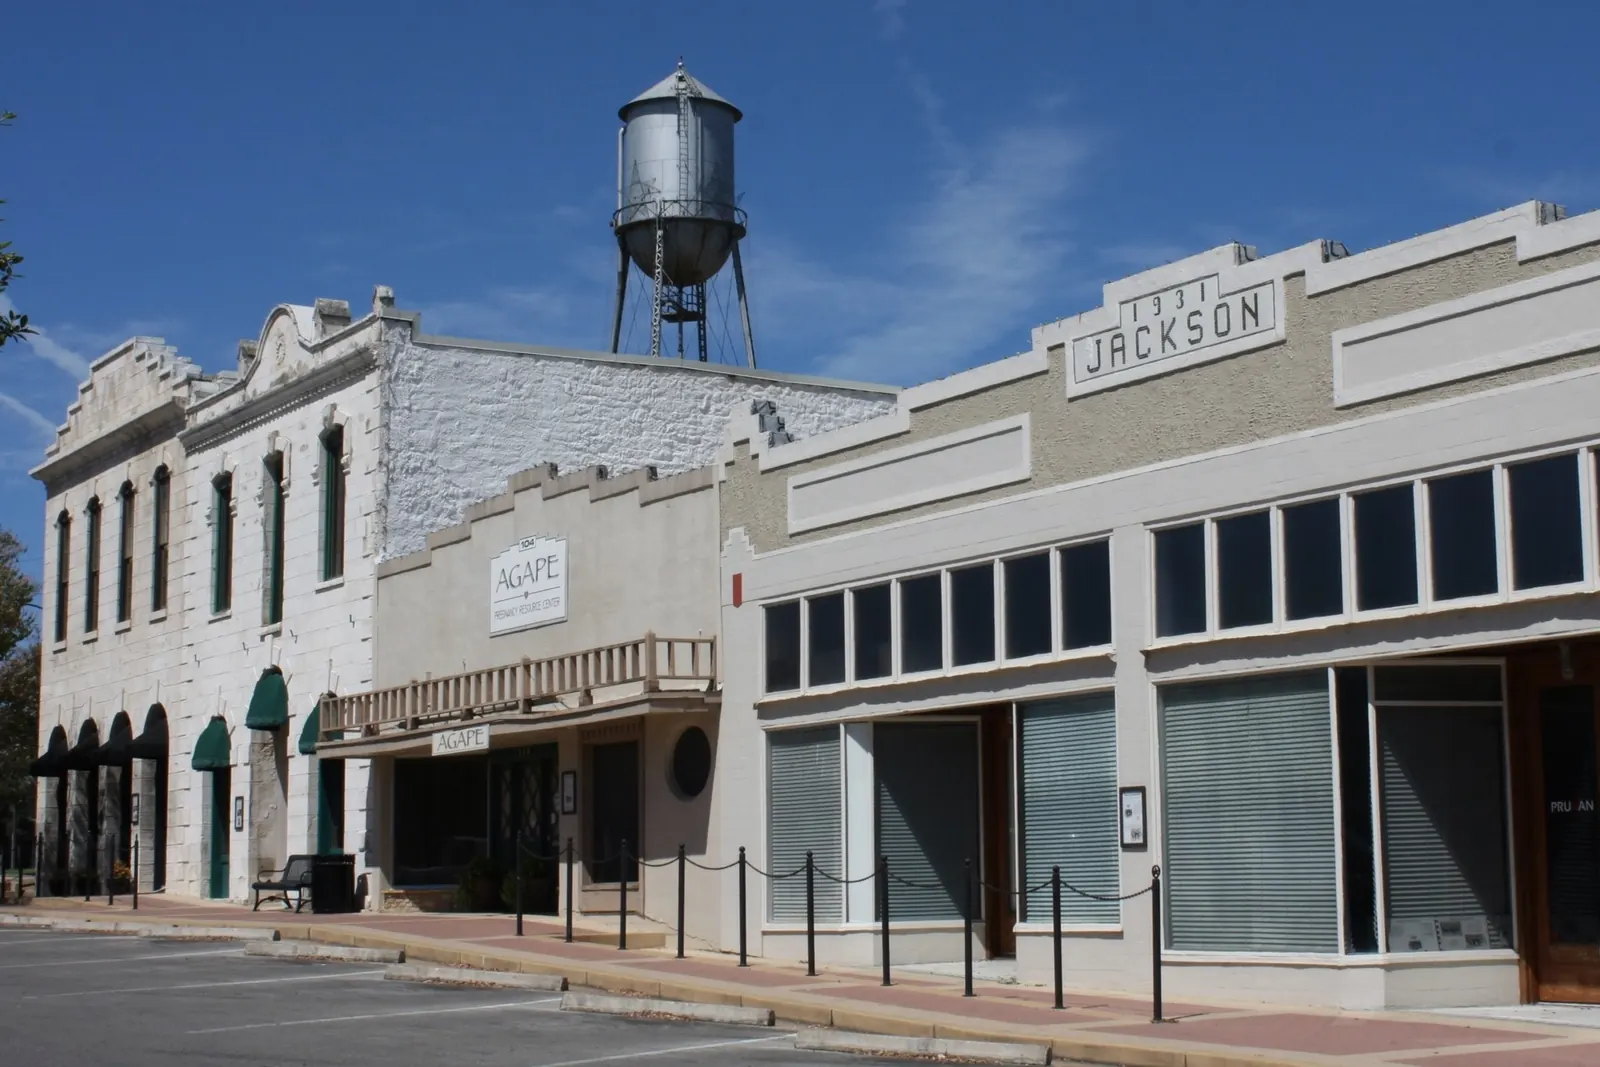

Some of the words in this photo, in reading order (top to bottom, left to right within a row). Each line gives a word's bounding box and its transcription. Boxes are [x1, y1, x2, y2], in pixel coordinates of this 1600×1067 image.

[1132, 281, 1206, 323] 1931
[1086, 292, 1260, 374] JACKSON
[520, 538, 536, 549] 104
[495, 554, 561, 594] AGAPE
[436, 728, 485, 751] AGAPE
